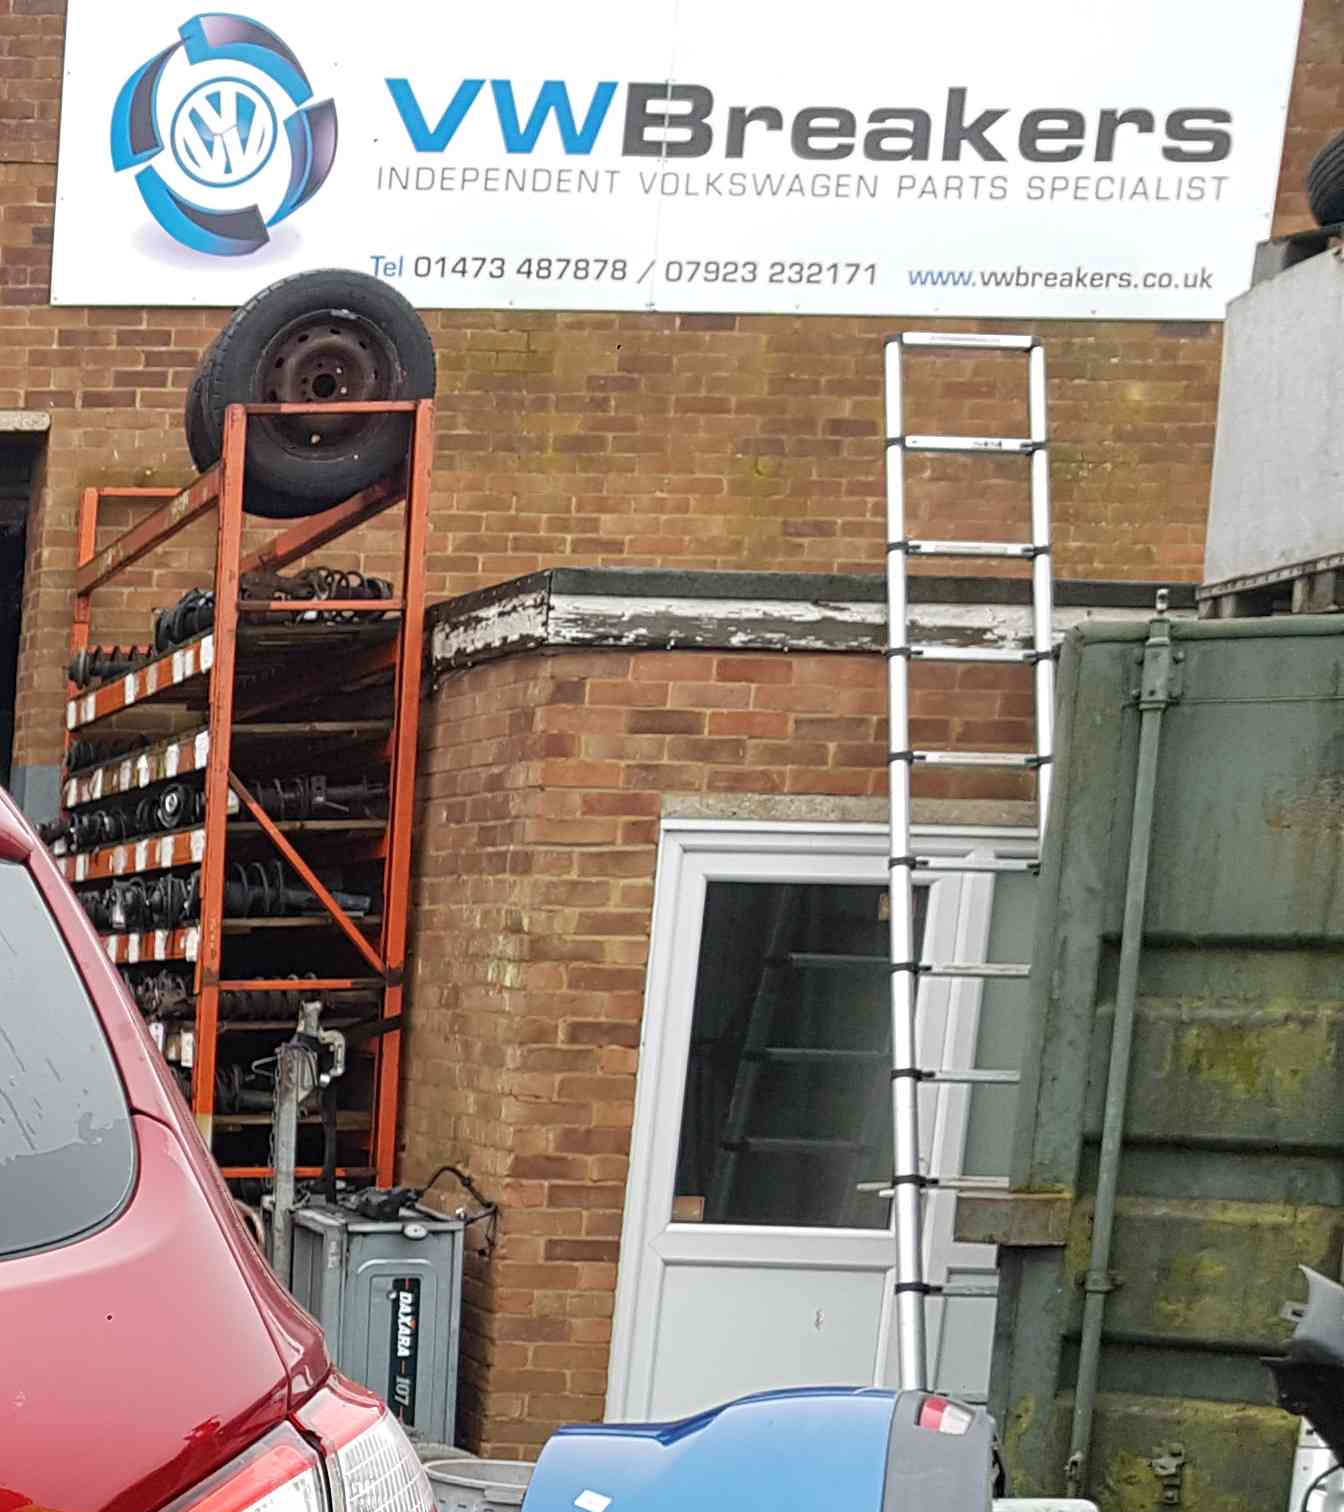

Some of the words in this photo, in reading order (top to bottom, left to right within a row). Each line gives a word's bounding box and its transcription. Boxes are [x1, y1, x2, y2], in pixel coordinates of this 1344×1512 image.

[384, 77, 1233, 163] VWBreakers
[377, 166, 620, 194] INDEPENDENT
[639, 171, 878, 199] VOLKSWAGEN
[897, 174, 1008, 200] PARTS
[1026, 176, 1228, 201] SPECIALIST
[370, 255, 404, 278] Tel
[413, 255, 506, 280] 01473
[515, 258, 628, 282] 487878
[664, 261, 758, 284] 07923
[768, 262, 877, 286] 232171
[908, 266, 1213, 290] www.vwbreakers.co.uk
[397, 1290, 413, 1358] DAXARA
[395, 1375, 411, 1406] 107
